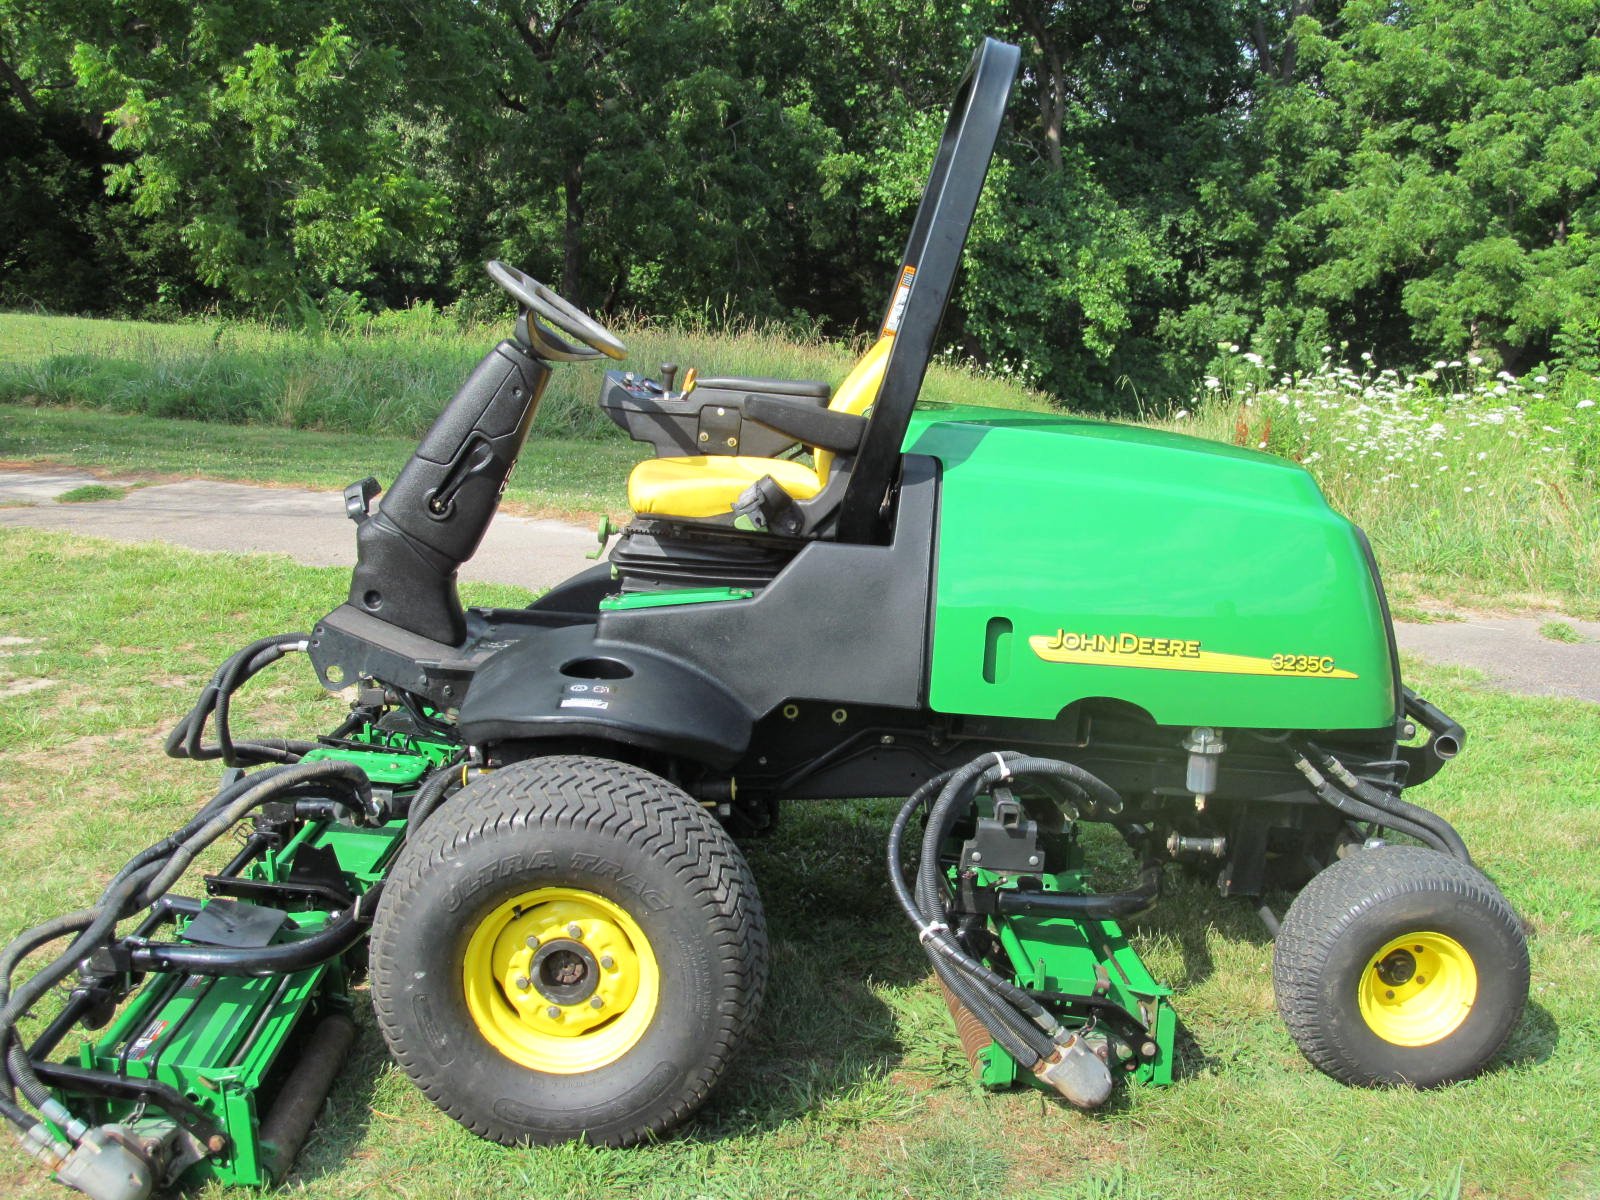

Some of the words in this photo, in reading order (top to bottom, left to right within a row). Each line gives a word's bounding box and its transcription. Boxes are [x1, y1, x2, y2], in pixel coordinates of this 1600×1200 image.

[1048, 629, 1116, 653] JOHN
[1120, 633, 1200, 658] DEERE
[1271, 654, 1335, 673] 3235C
[442, 850, 557, 913] ULTRA
[570, 853, 673, 912] TRAC
